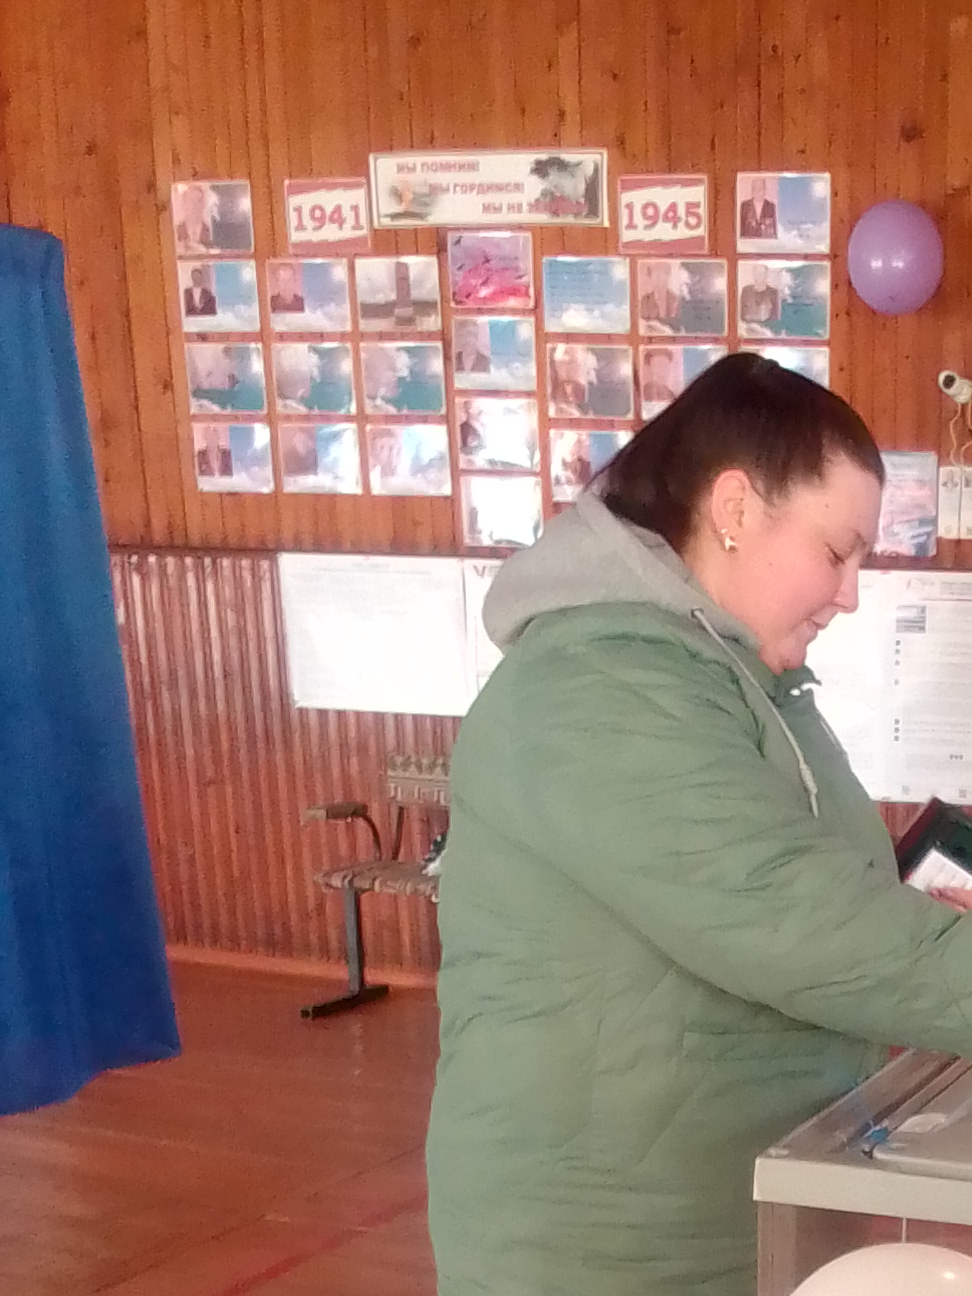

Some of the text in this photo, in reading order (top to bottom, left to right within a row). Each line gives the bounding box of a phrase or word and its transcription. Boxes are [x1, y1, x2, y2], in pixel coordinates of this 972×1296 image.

[396, 161, 417, 174] МЫ
[292, 204, 364, 232] 1941
[482, 202, 503, 214] МЫ
[624, 201, 702, 230] 1945
